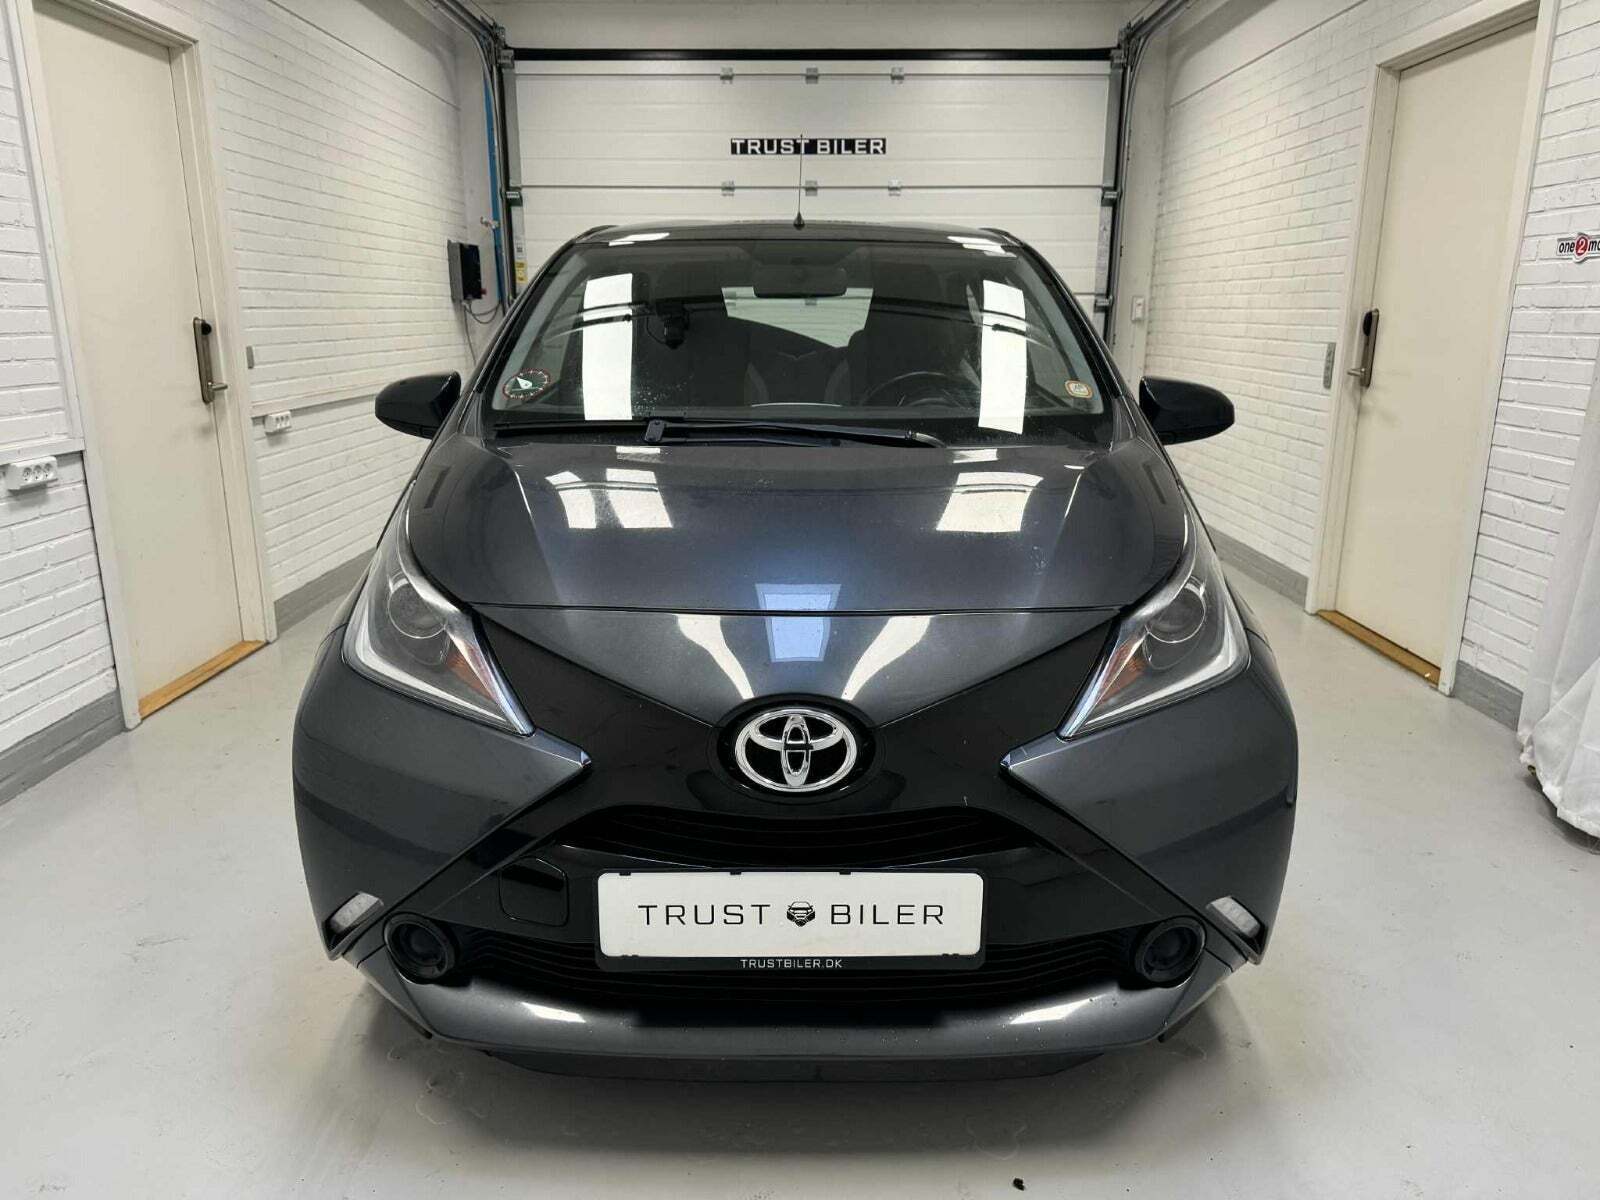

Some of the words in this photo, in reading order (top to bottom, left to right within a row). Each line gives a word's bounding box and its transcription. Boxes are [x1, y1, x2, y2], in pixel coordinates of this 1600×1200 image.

[732, 139, 809, 154] TRUST
[817, 139, 883, 154] BILER
[637, 903, 771, 926] TRUST
[830, 903, 944, 926] BILER
[740, 958, 843, 969] TRUSTBILER.DK
